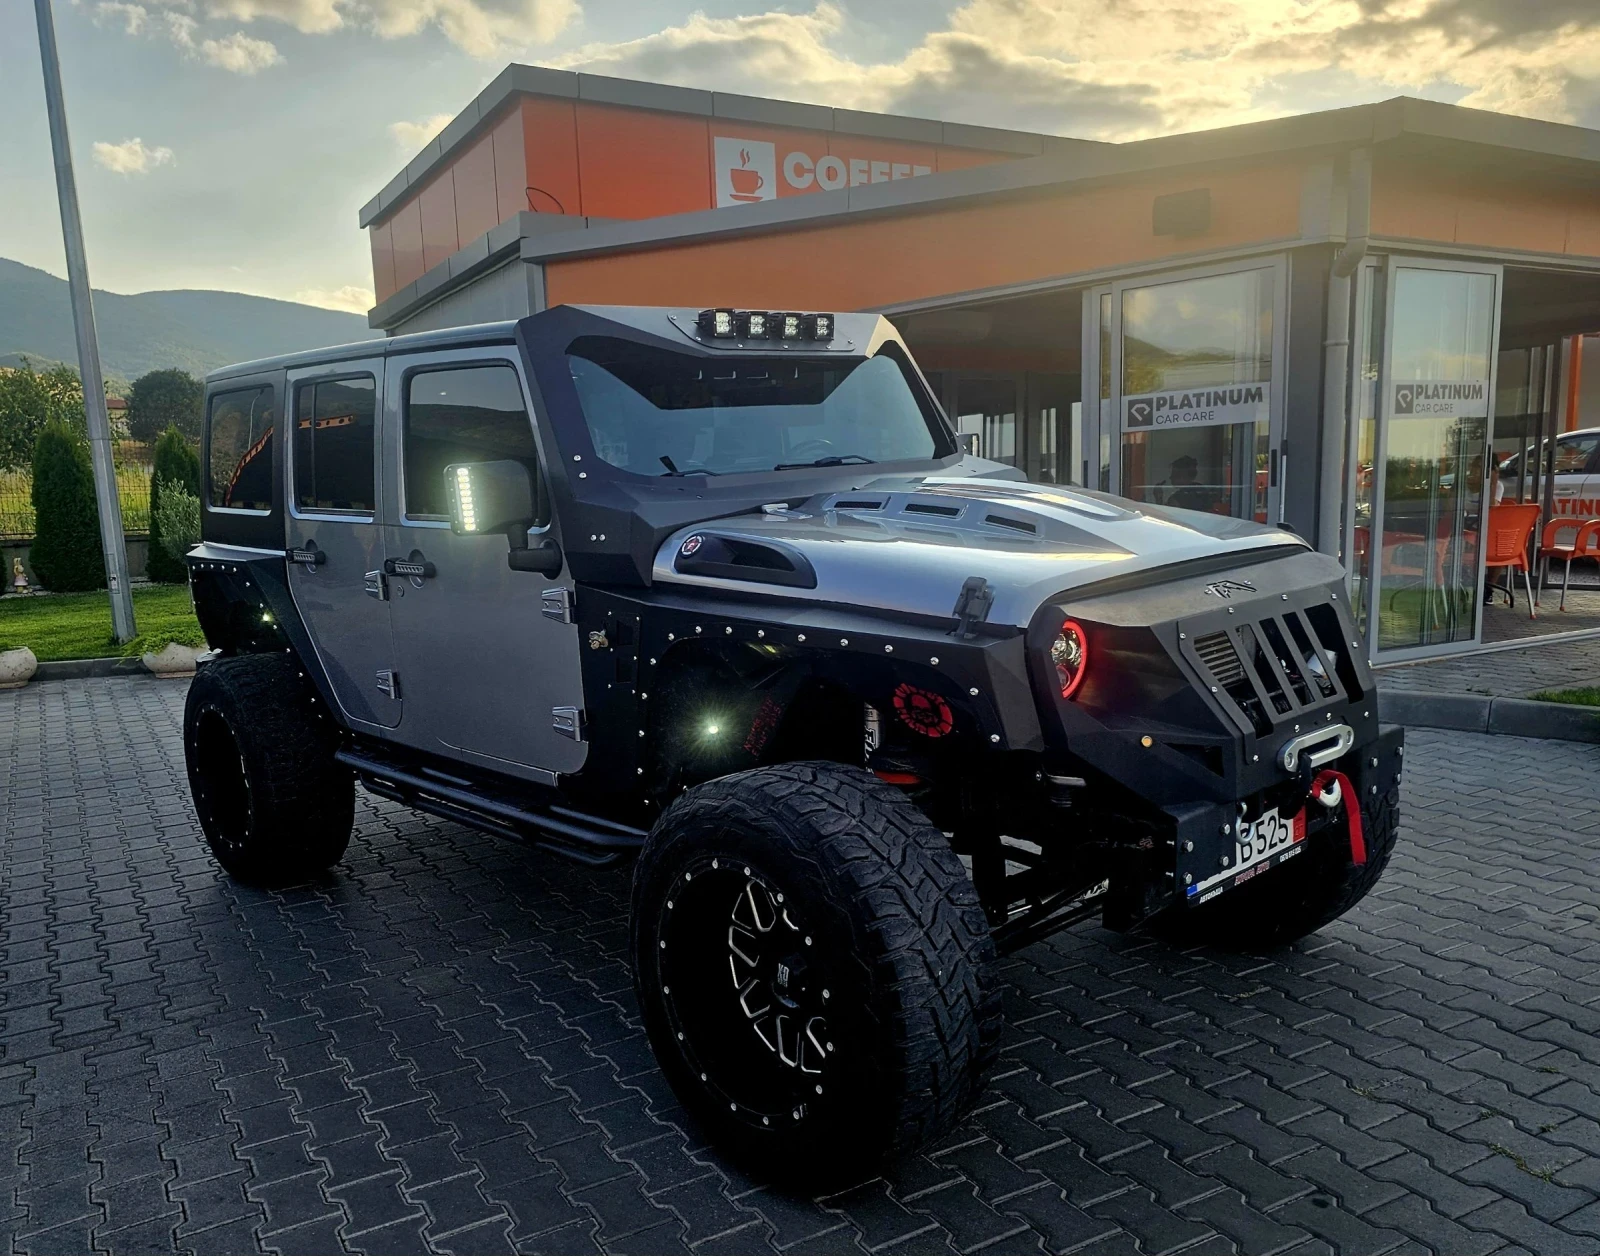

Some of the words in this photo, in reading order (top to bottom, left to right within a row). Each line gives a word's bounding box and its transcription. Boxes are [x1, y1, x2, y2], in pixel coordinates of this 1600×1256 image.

[1155, 386, 1263, 412] PLATINUM
[1415, 384, 1483, 400] PLATINUM
[1414, 403, 1432, 414] CAR
[1432, 403, 1454, 413] CARE
[1155, 413, 1180, 425] CAR
[1183, 410, 1215, 422] CARE
